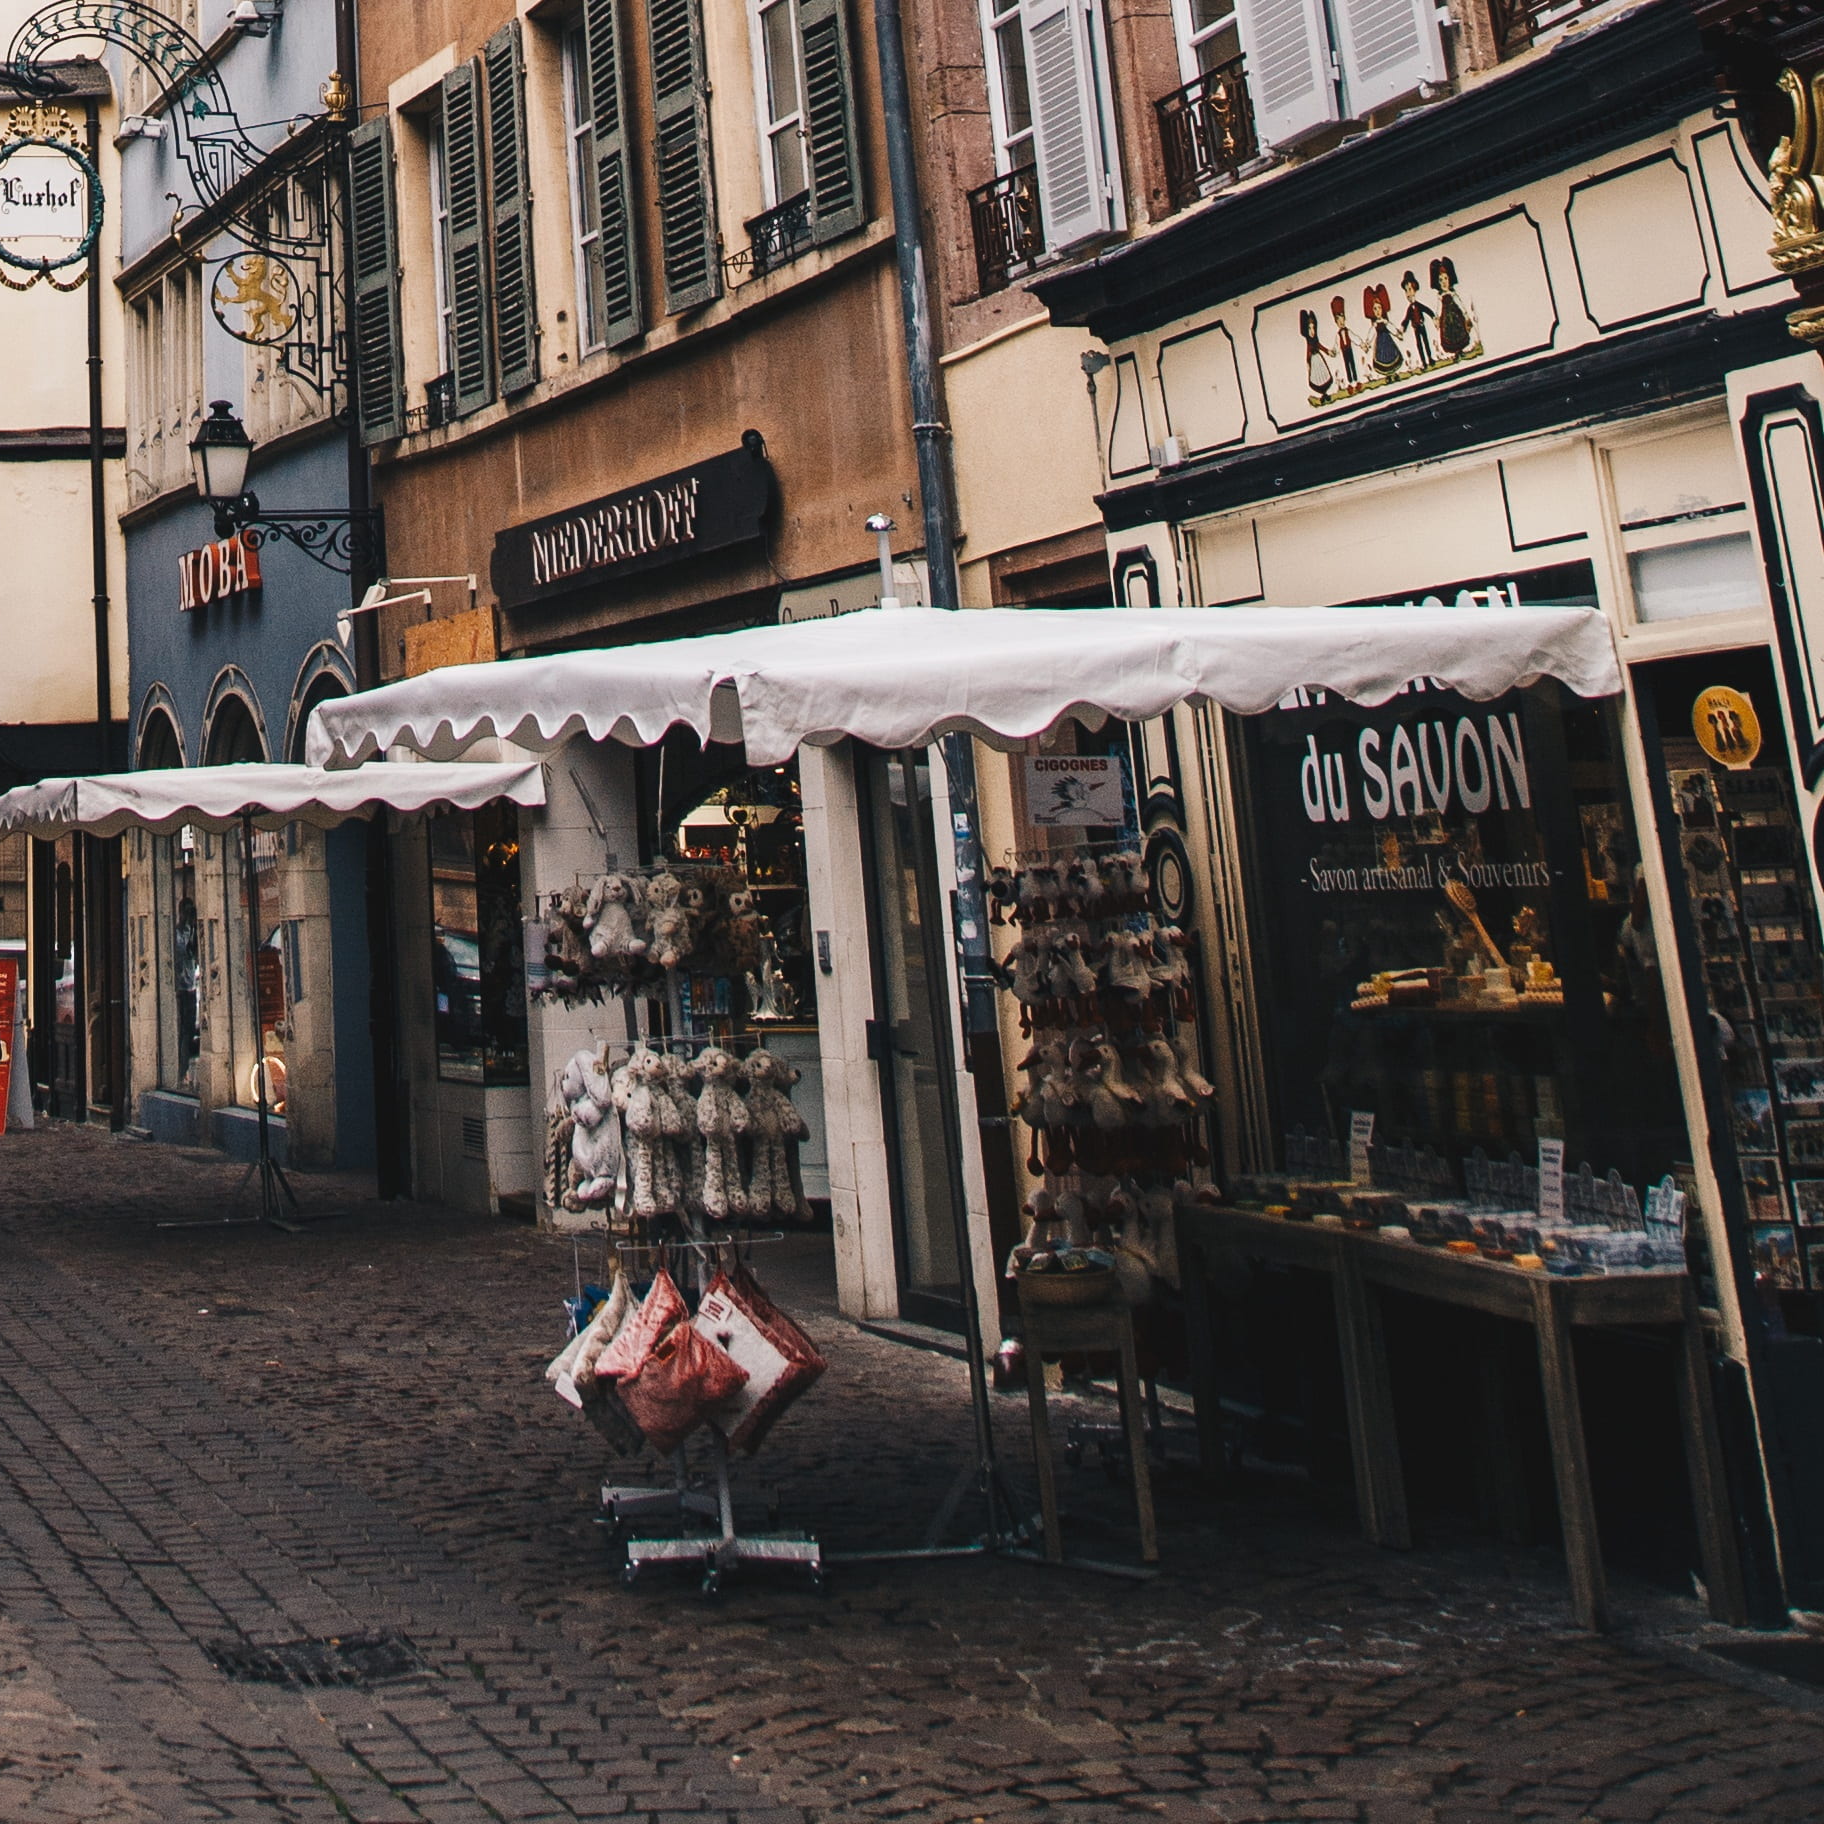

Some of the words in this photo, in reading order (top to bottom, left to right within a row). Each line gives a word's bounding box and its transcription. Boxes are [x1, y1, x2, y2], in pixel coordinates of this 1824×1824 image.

[532, 477, 700, 585] NIEDERHOFF
[178, 532, 249, 611] MOBA
[1034, 759, 1108, 772] CIGOGNES
[1301, 734, 1350, 822] du
[1358, 712, 1531, 819] SAVON
[1309, 857, 1359, 892] Savon
[1362, 854, 1434, 890] artisanal
[1457, 851, 1551, 888] Souvenirs
